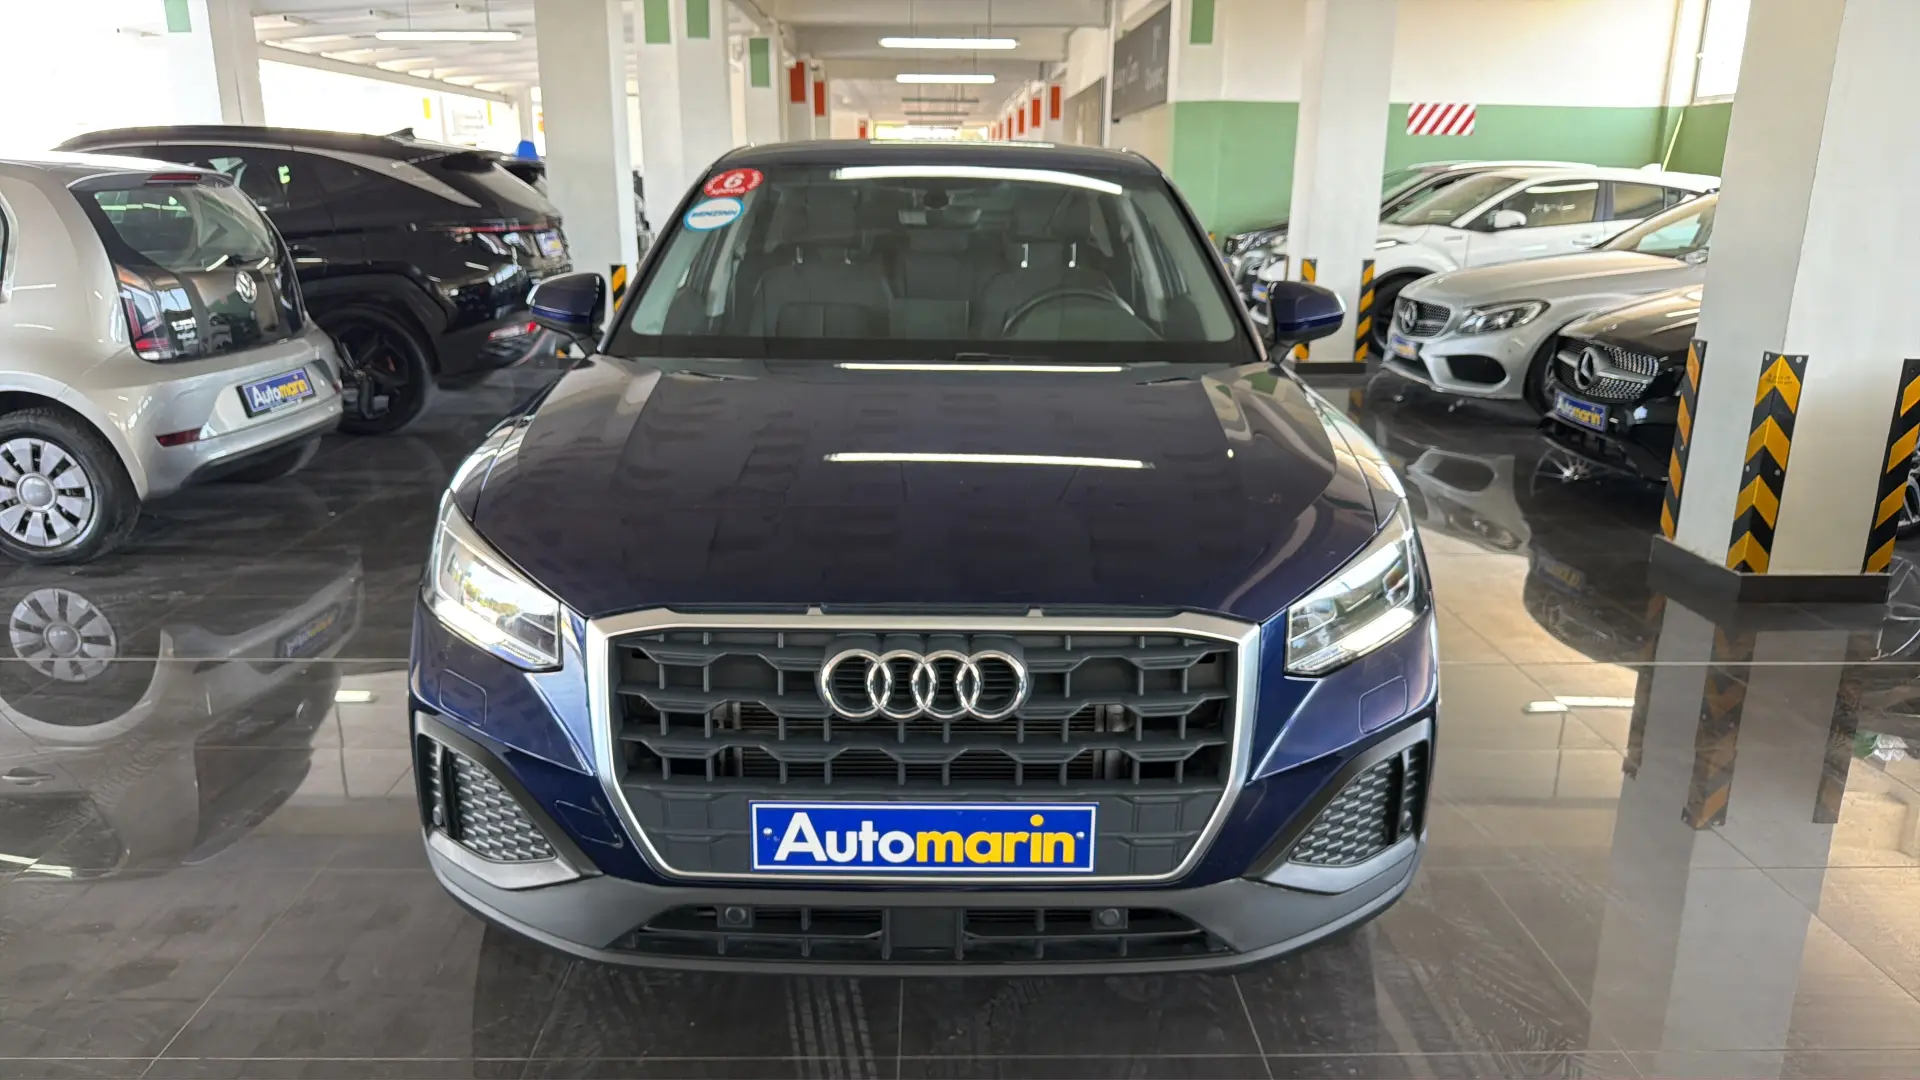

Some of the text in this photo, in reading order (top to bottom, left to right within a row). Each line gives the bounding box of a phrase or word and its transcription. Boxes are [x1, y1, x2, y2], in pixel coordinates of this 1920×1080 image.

[723, 172, 745, 189] 6
[251, 374, 309, 408] Automarin
[774, 811, 1076, 863] Automarin
